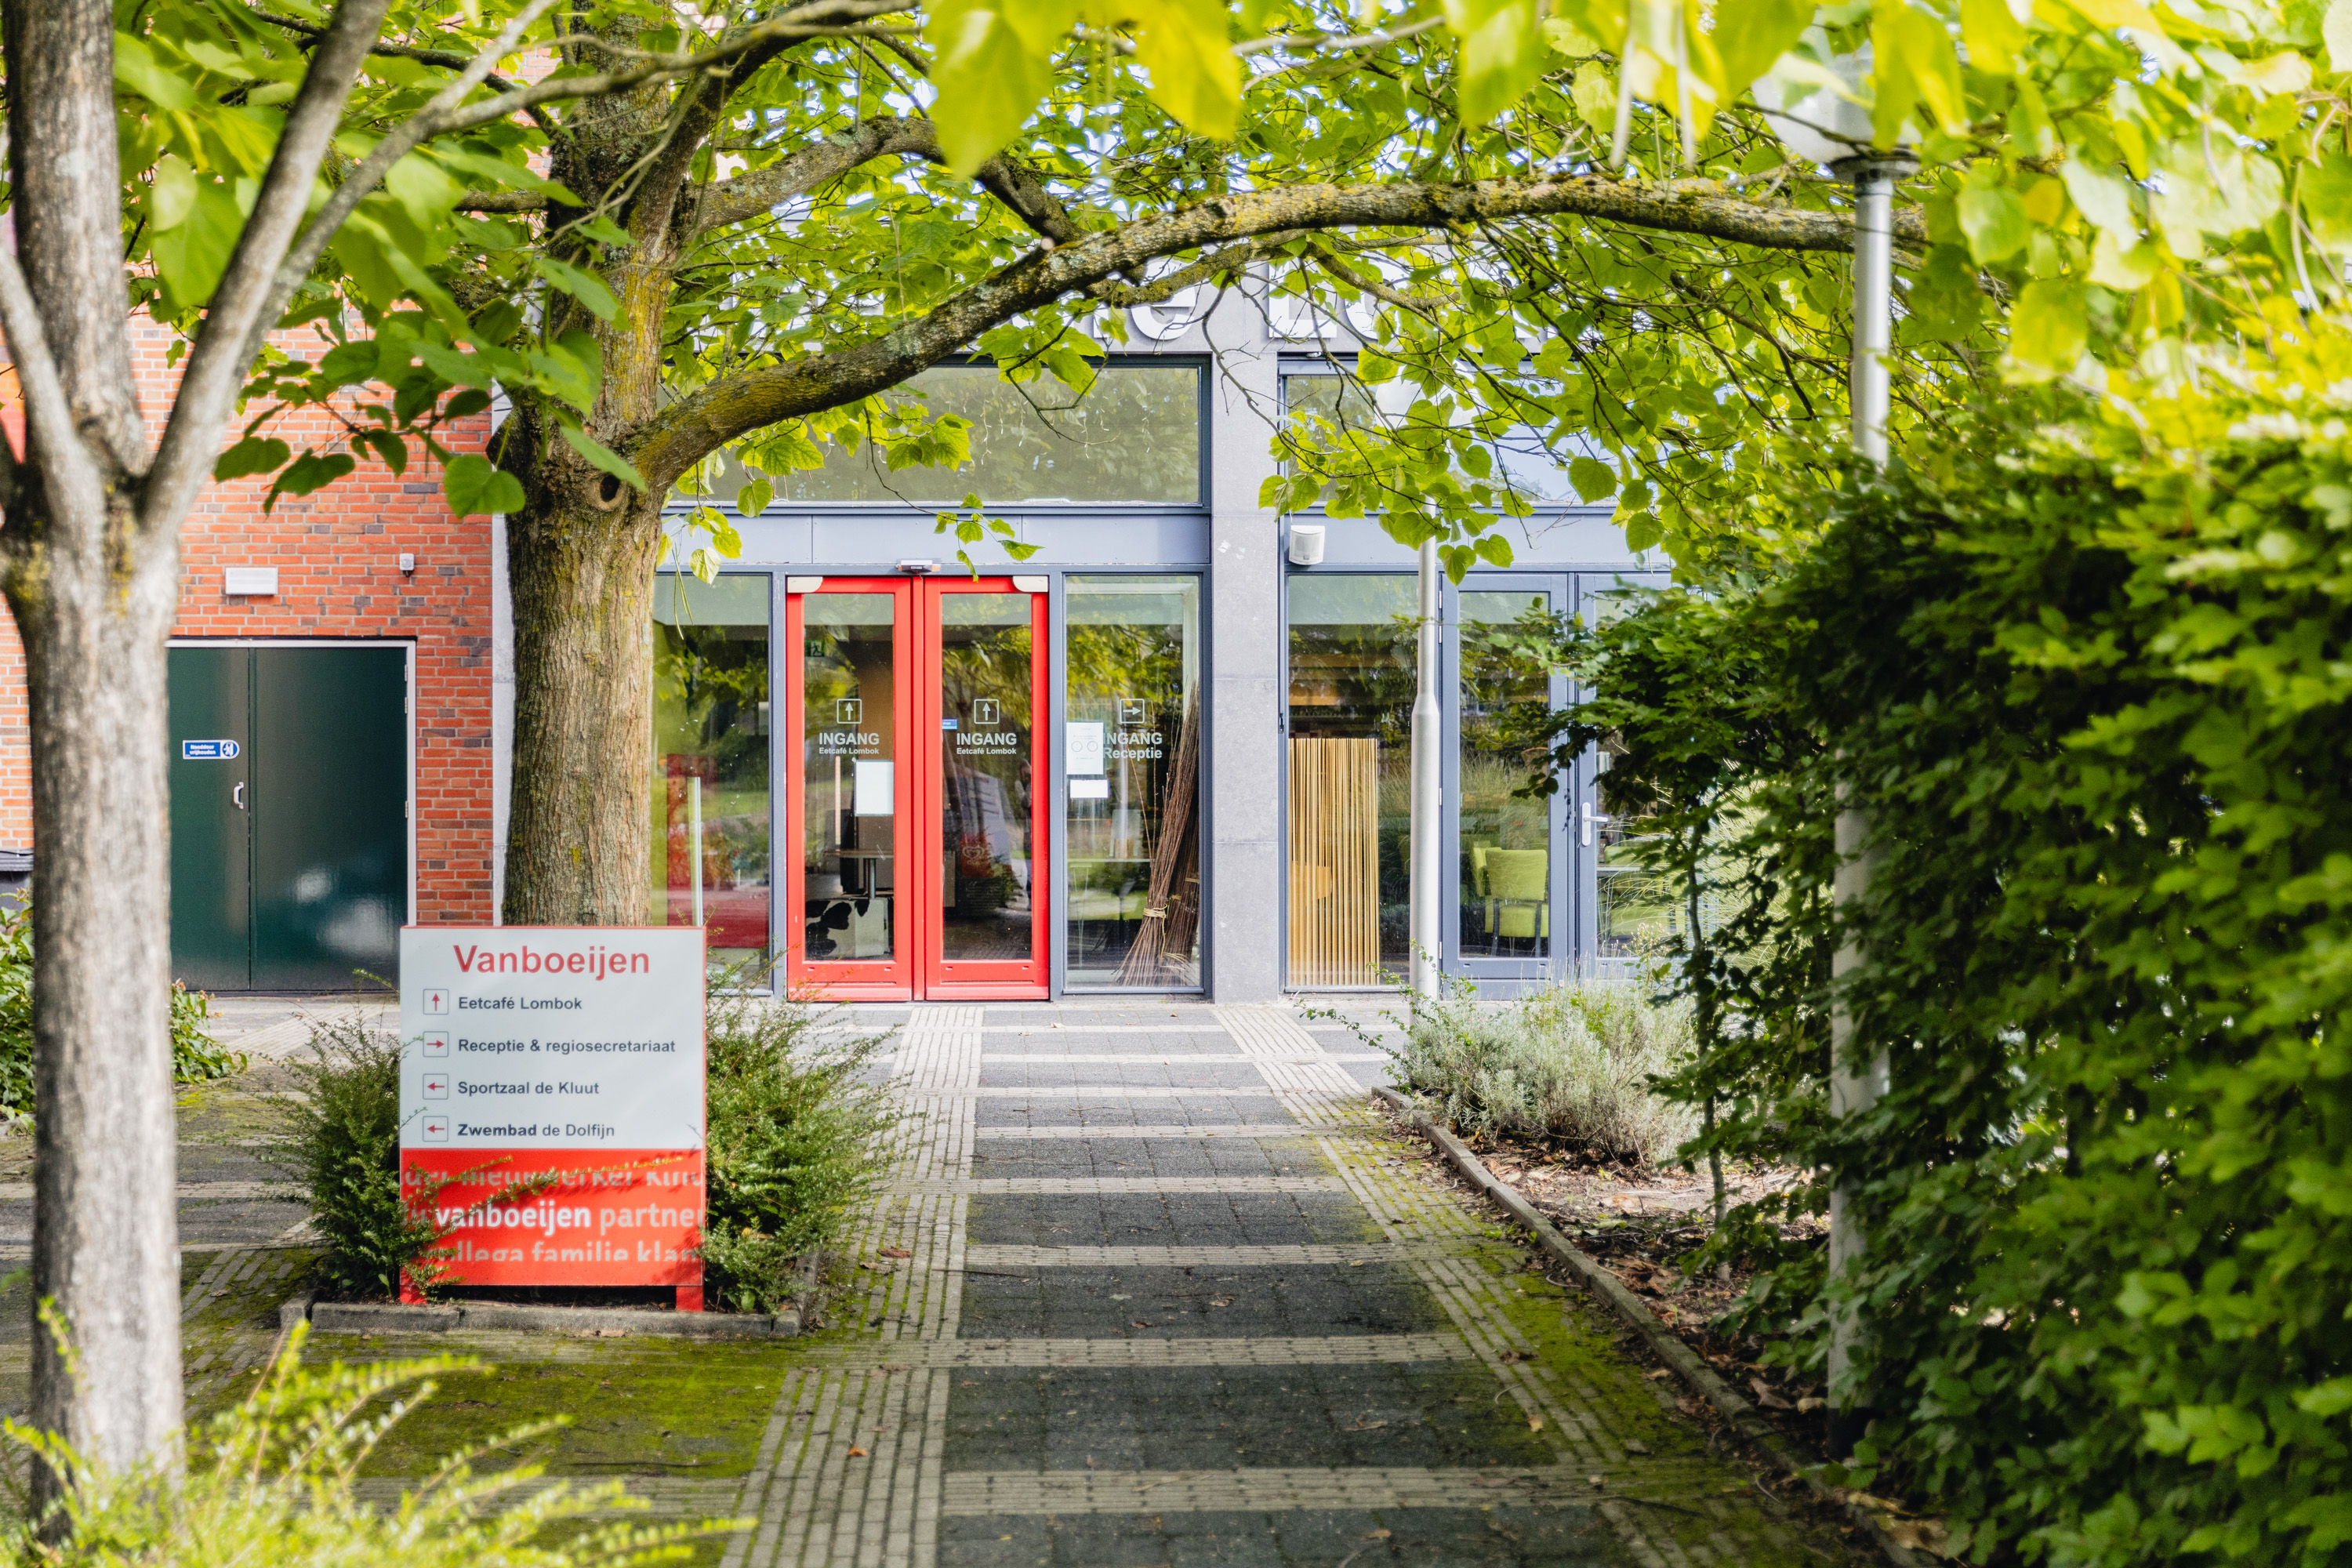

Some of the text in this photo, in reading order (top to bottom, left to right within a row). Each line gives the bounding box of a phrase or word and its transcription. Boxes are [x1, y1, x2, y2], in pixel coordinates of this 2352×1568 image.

[819, 732, 880, 745] INGANG
[956, 732, 1016, 745] INGANG
[1103, 732, 1162, 745] INGANG
[1103, 747, 1162, 760] Receptie
[453, 945, 650, 981] Vanboeijen
[458, 996, 583, 1010] Eetcafé Lombok
[458, 1039, 676, 1055] Receptie & regiosecretariaat
[457, 1081, 600, 1097] Sportzaal de Kluut
[457, 1123, 615, 1139] Zwembad de Dolfijn
[436, 1200, 591, 1236] vanboeijen
